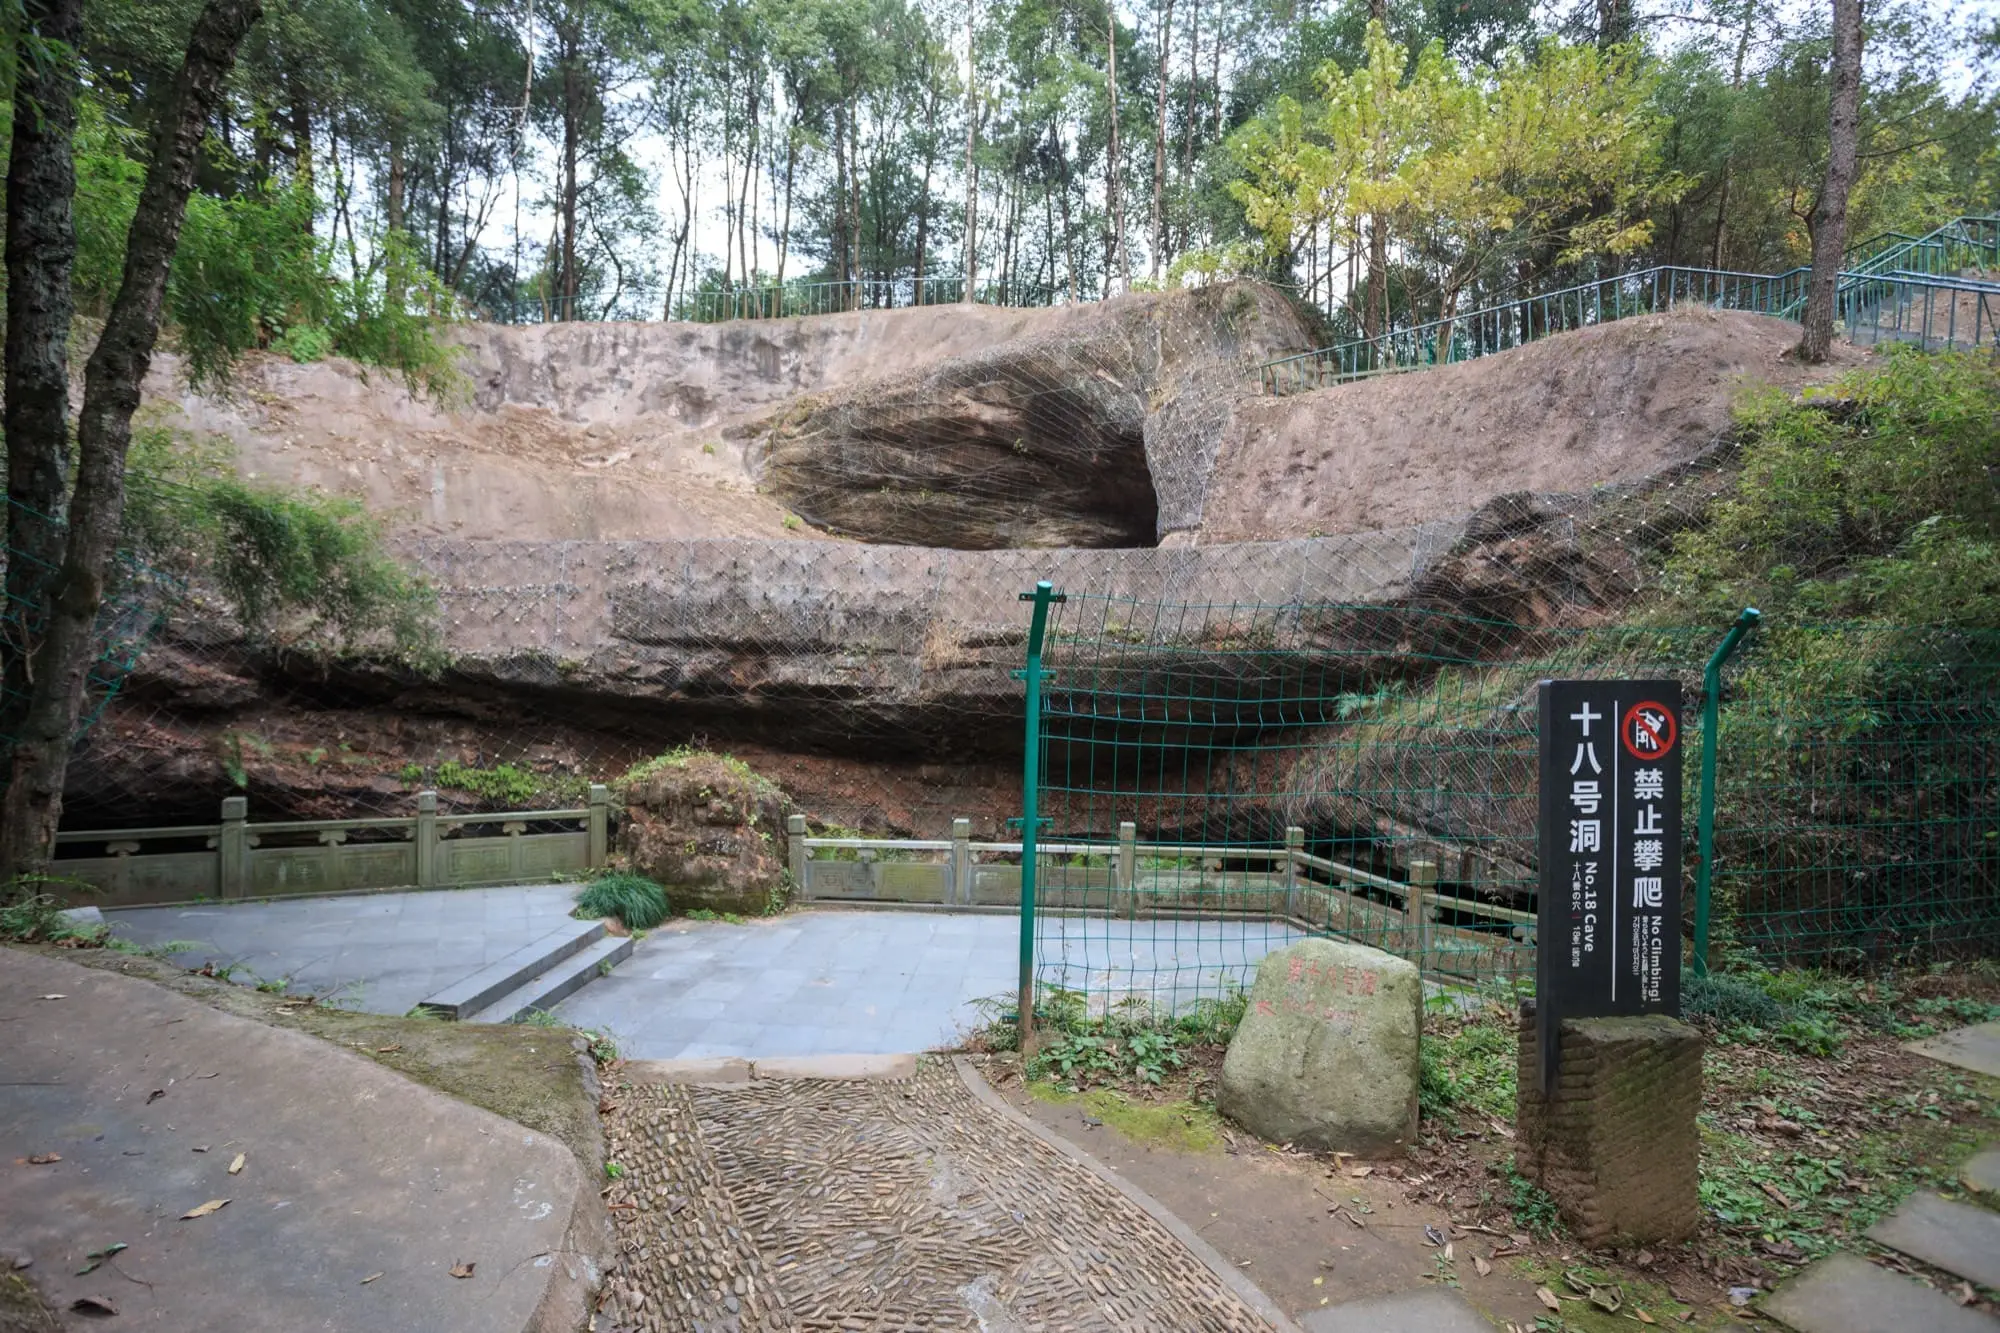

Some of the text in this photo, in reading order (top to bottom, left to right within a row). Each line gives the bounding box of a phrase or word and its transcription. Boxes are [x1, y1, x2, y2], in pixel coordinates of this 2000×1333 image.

[1569, 701, 1602, 853] 十八号洞
[1632, 768, 1664, 908] 禁止攀爬
[1584, 861, 1598, 952] No.18 Cave
[1648, 915, 1662, 1002] No Climbing!
